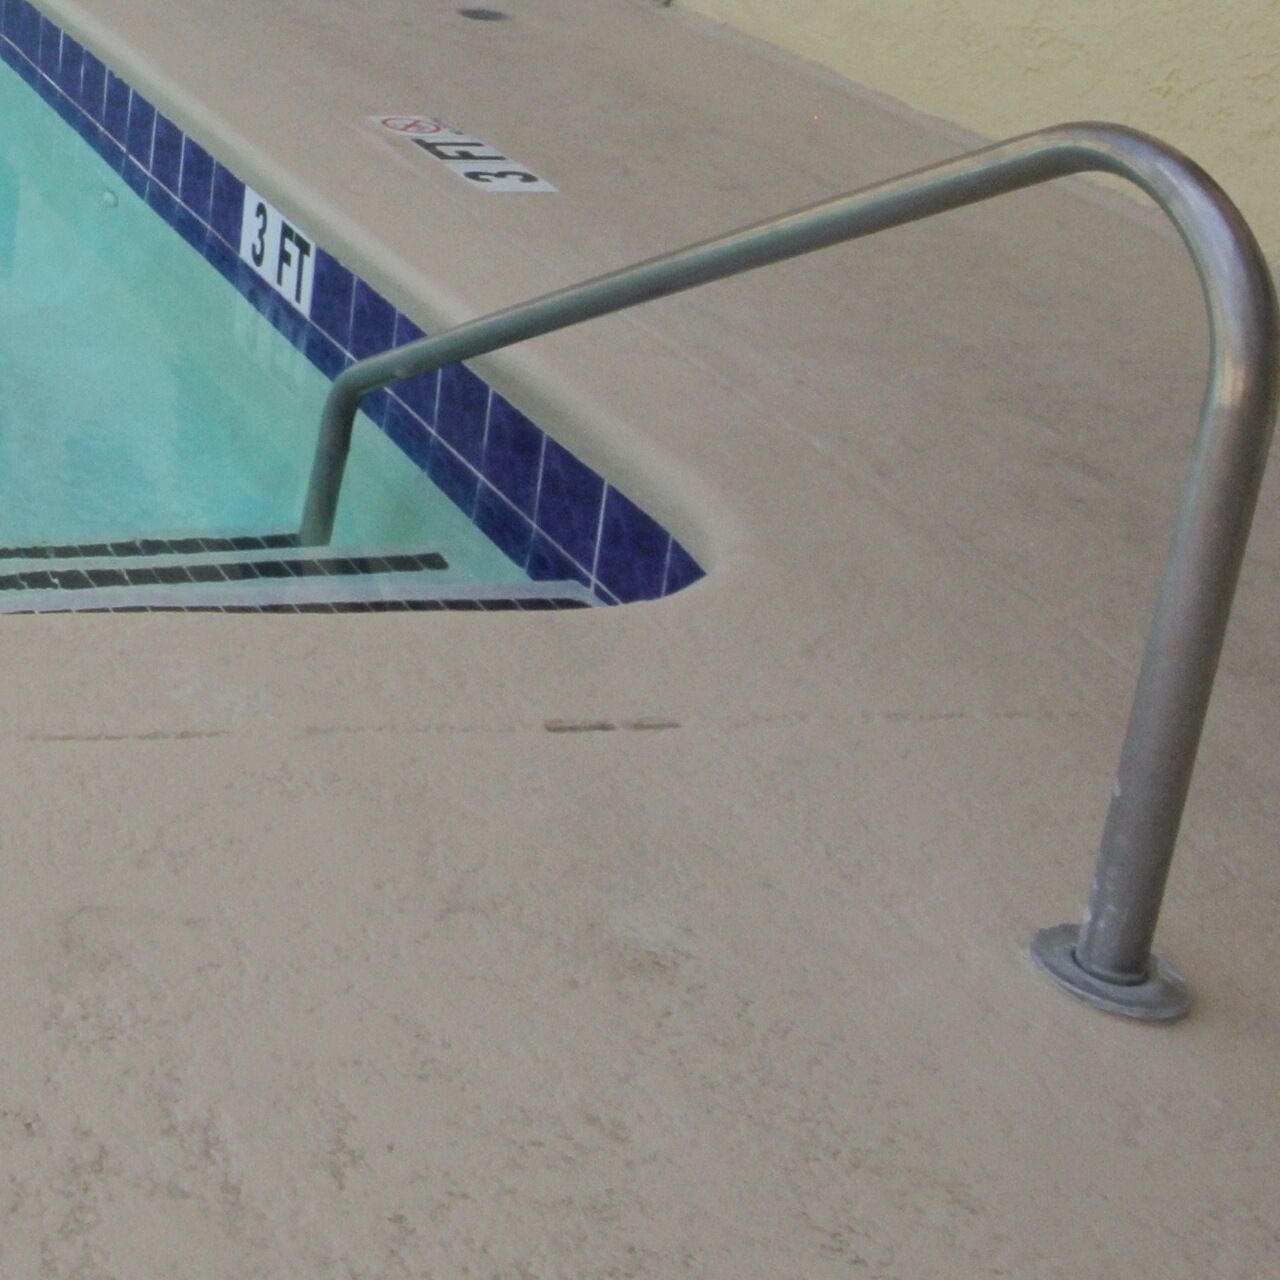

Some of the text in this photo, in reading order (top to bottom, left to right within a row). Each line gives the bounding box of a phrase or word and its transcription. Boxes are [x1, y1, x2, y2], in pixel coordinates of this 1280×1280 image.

[410, 138, 538, 183] 3 FT
[252, 202, 311, 304] 3 FT
